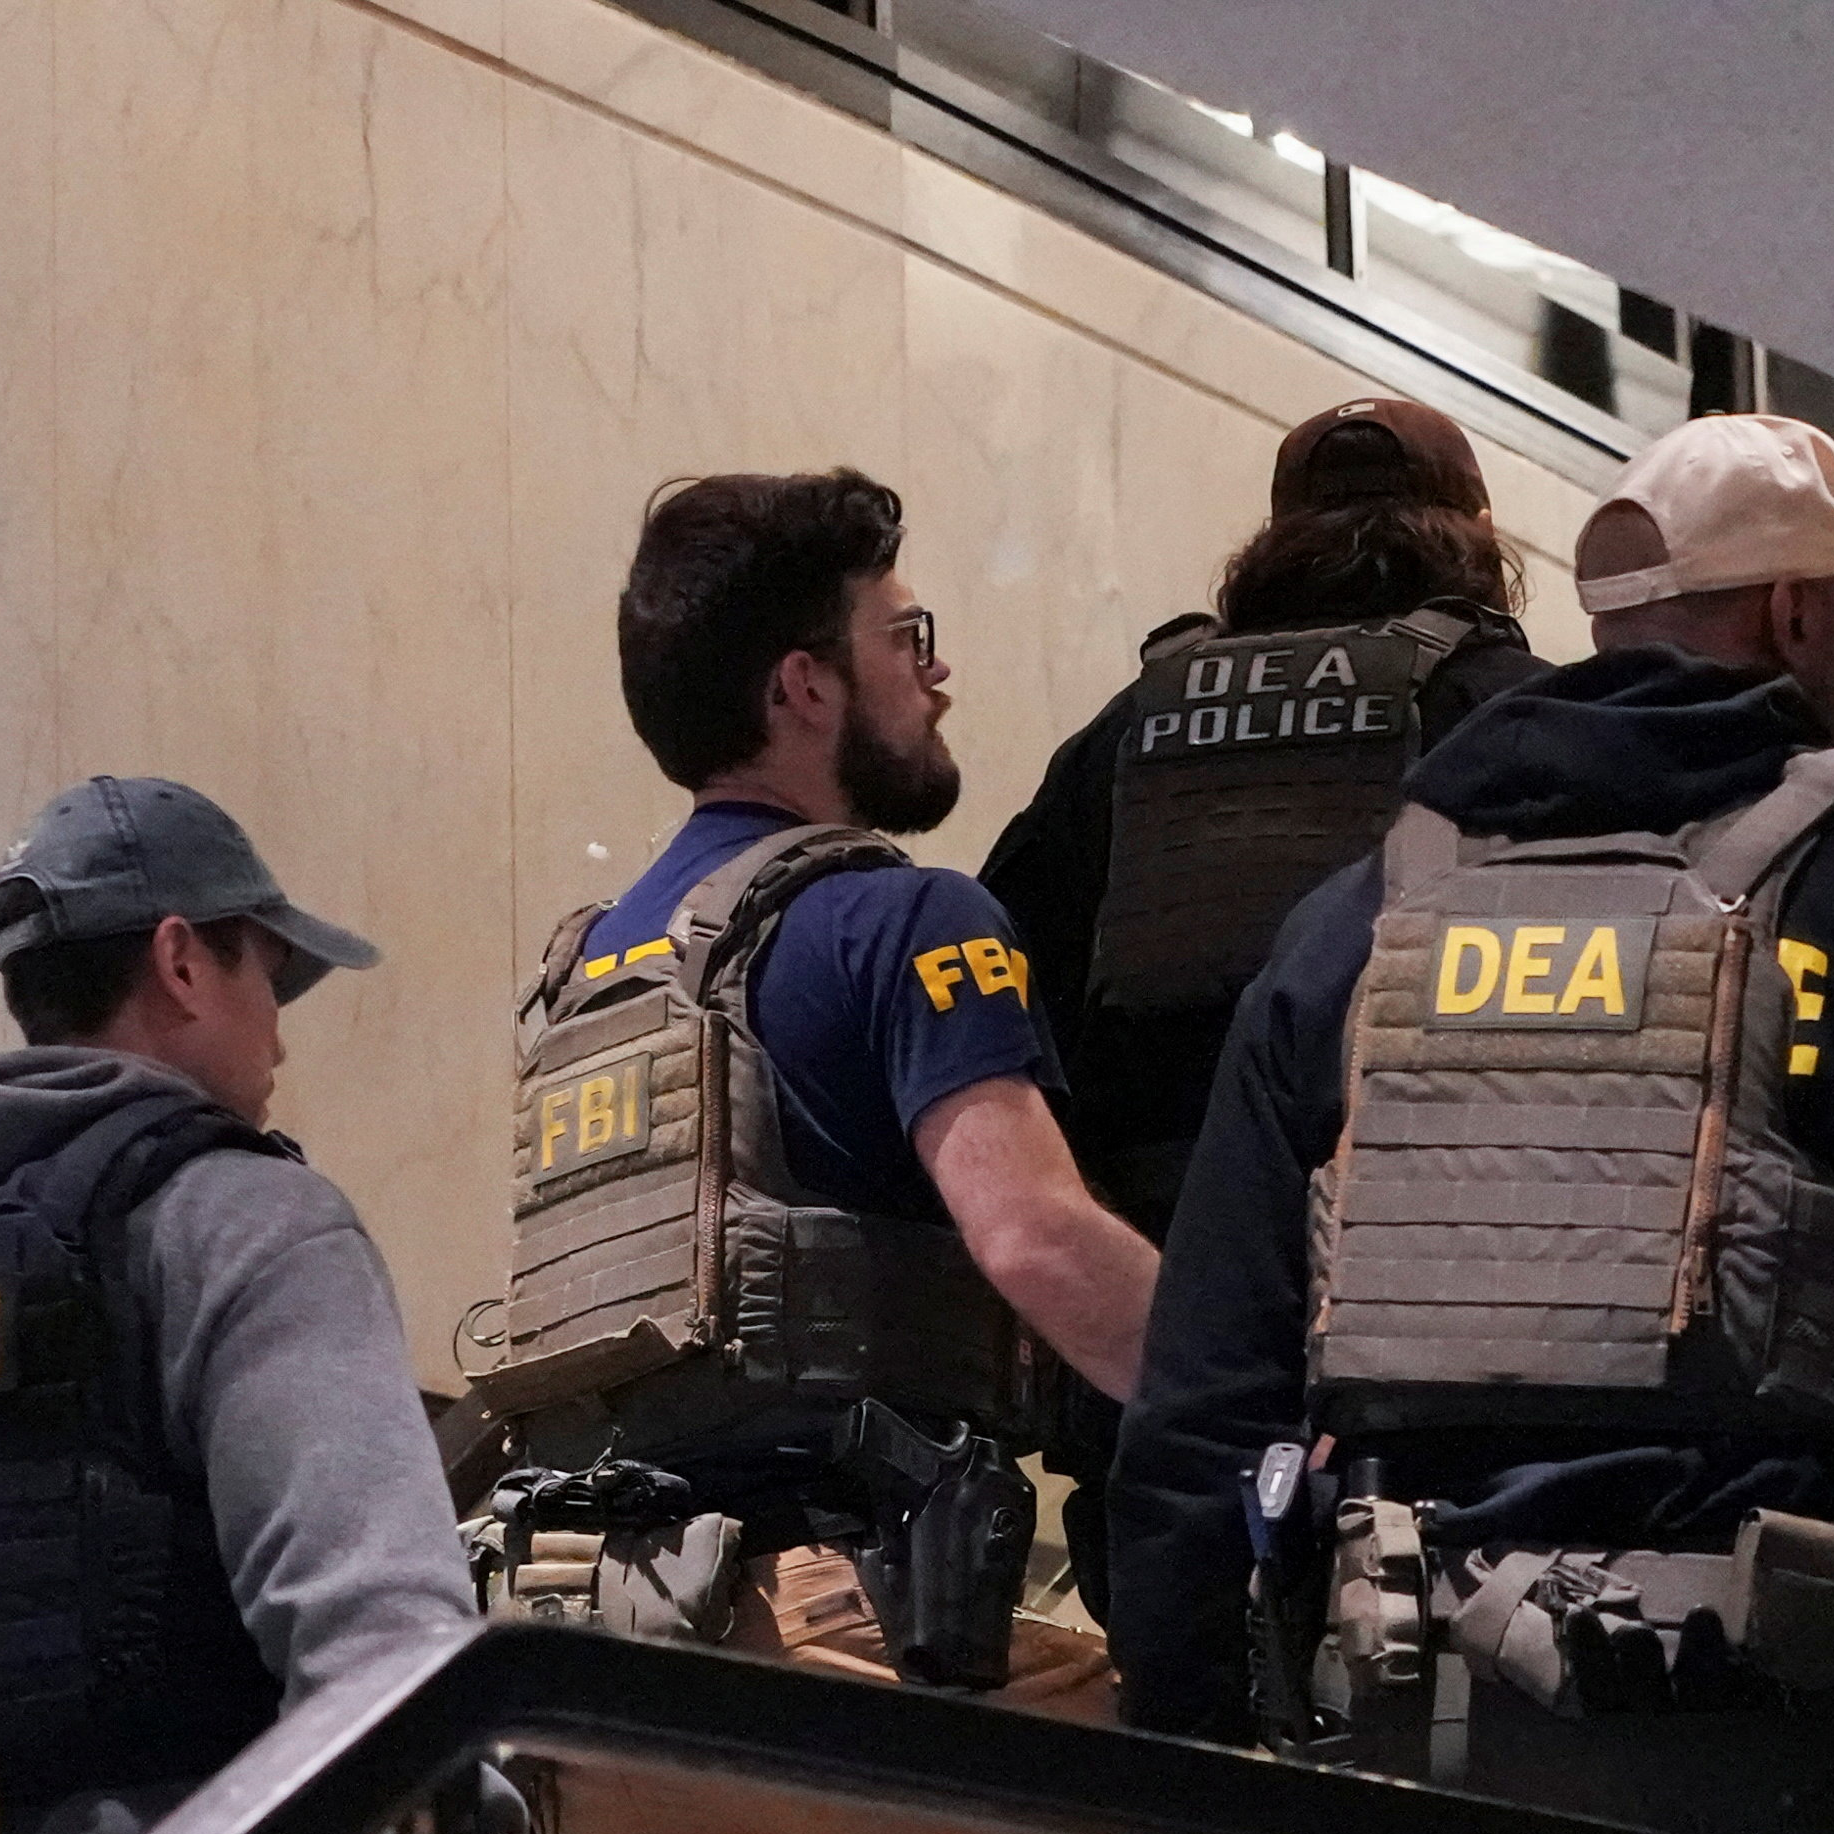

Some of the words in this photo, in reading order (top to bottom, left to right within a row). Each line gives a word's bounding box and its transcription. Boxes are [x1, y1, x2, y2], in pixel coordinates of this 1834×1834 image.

[1183, 646, 1357, 701] DEA
[1141, 694, 1395, 754] POLICE
[912, 936, 1029, 1013] FBI
[1436, 925, 1626, 1016] DEA
[541, 1065, 641, 1172] FBI
